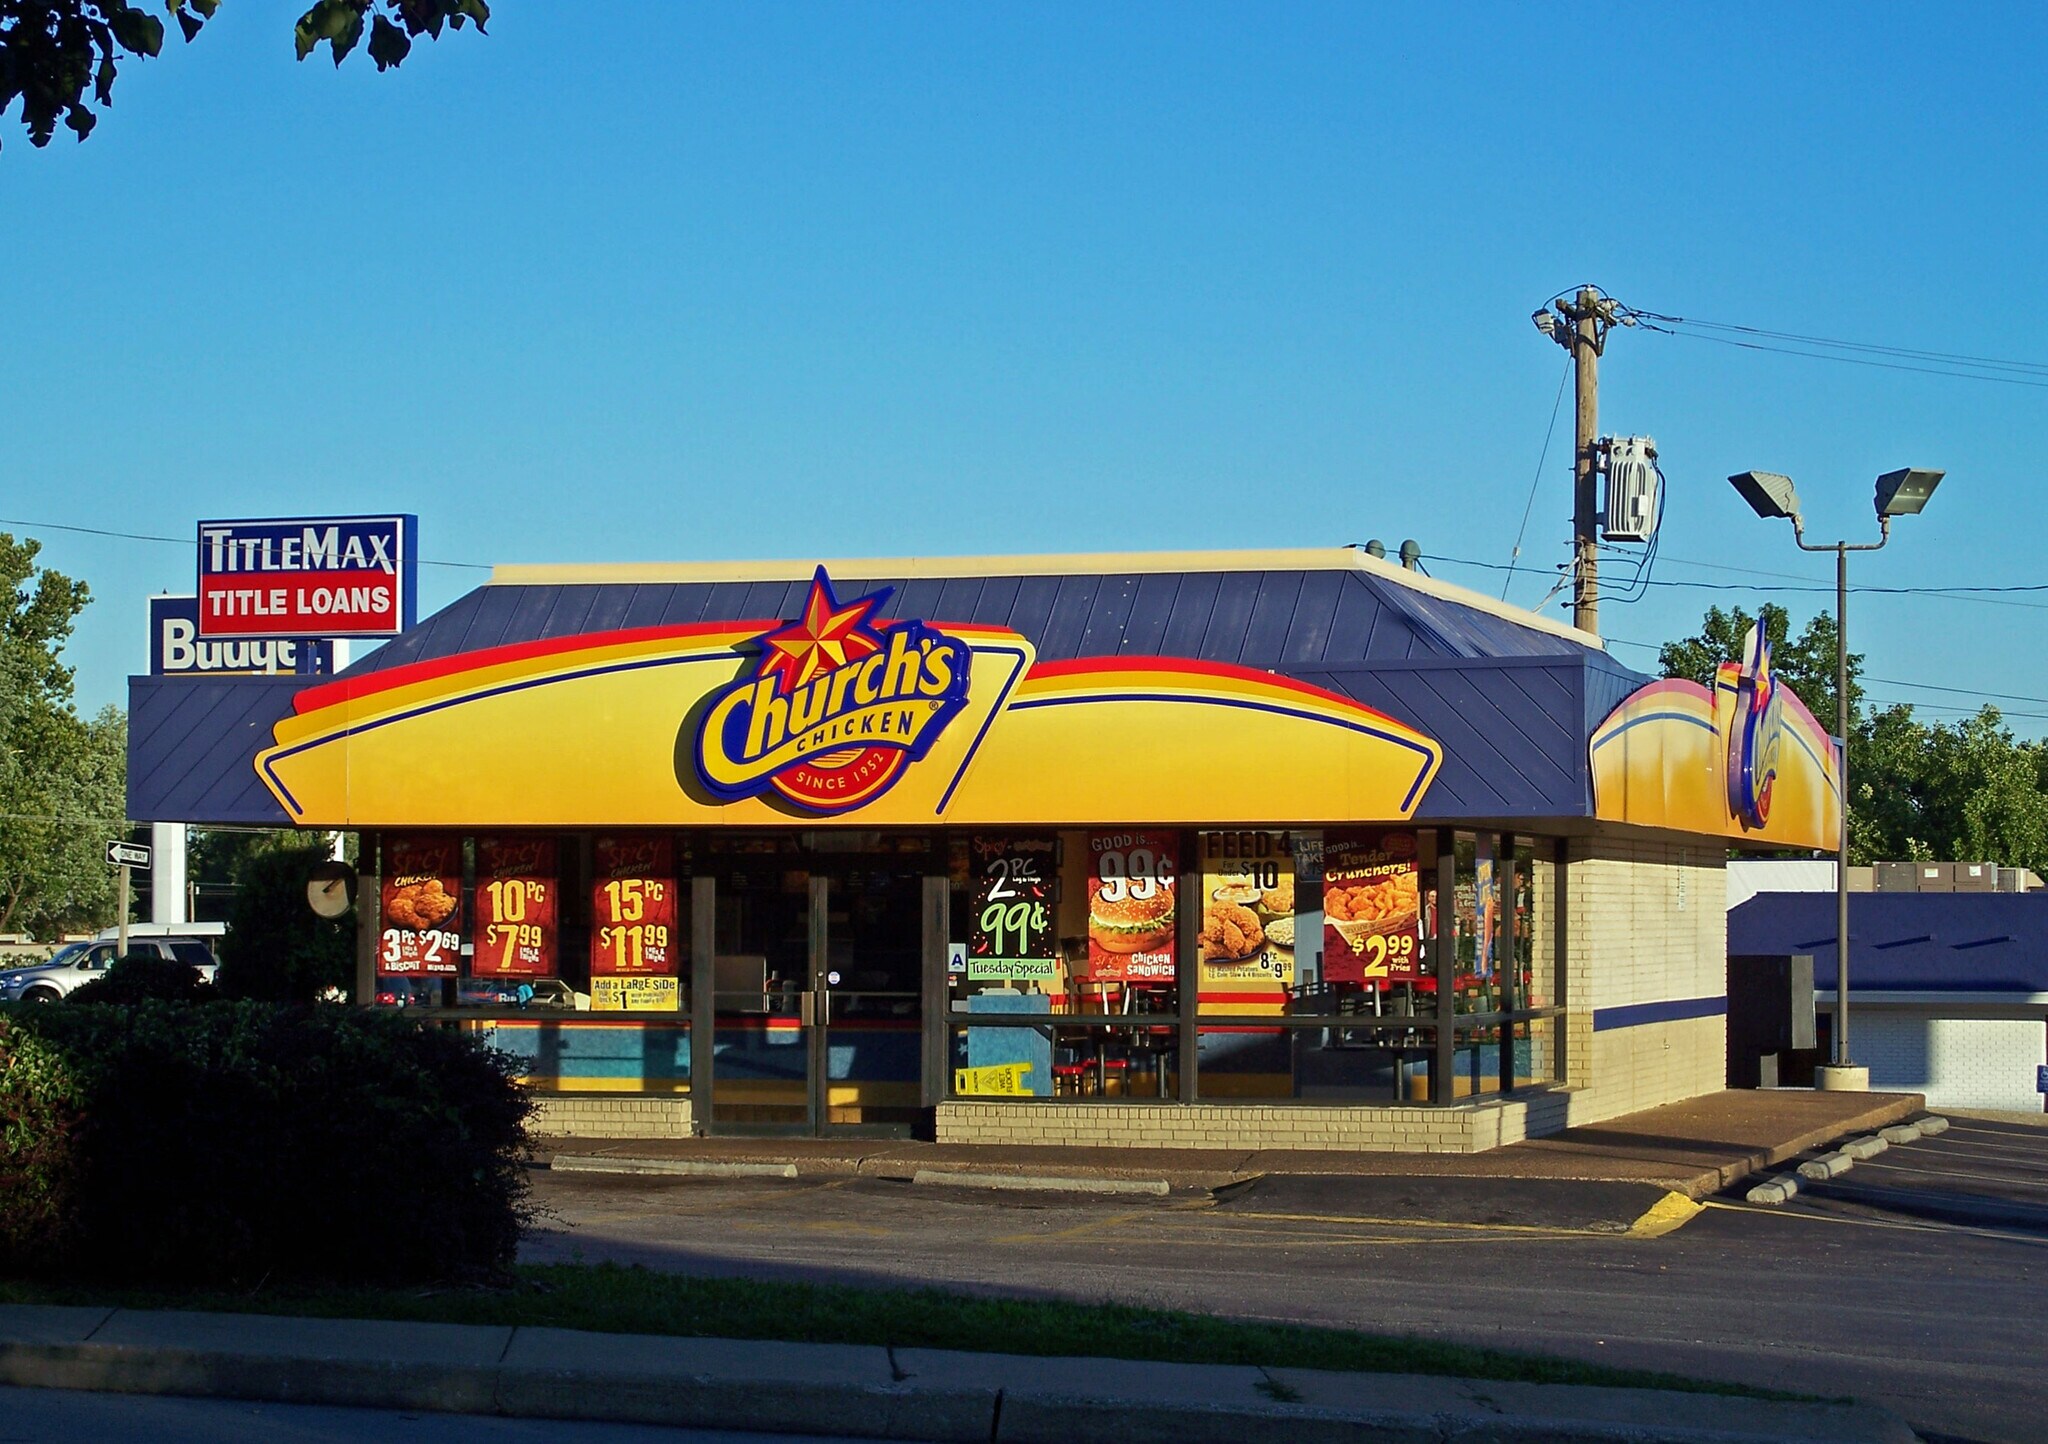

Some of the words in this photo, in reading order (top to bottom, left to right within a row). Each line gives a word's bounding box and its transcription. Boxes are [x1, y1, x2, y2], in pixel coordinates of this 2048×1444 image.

[207, 589, 288, 616] TITLE
[297, 586, 391, 614] LOANS
[702, 631, 955, 785] Church's
[796, 710, 914, 752] CHICKEN
[796, 771, 846, 790] SINCE
[853, 752, 885, 782] 1952
[121, 849, 133, 859] ONE
[134, 851, 147, 861] WAY
[491, 842, 545, 869] SPICY
[608, 840, 662, 867] SPICY
[974, 836, 1008, 860] Spicy
[1091, 834, 1132, 851] GOOD
[1206, 832, 1271, 858] FEED
[1277, 830, 1292, 858] 4
[610, 861, 652, 877] CHICKEN
[1339, 848, 1393, 866] Tender
[987, 858, 1016, 902] 2
[1010, 857, 1037, 876] PC
[1099, 848, 1176, 902] 99¢
[1217, 868, 1240, 877] Under
[1240, 860, 1279, 890] $10
[486, 879, 526, 922] 10
[526, 880, 546, 903] PC
[604, 878, 644, 922] 15
[644, 880, 664, 901] PC
[980, 901, 1049, 955] 99¢
[383, 928, 402, 962] 3
[401, 929, 416, 946] PC
[951, 953, 964, 966] A
[1261, 952, 1269, 969] 8
[1391, 955, 1409, 964] with
[594, 980, 611, 989] Add
[612, 991, 628, 1010] $1
[1005, 1067, 1013, 1093] FLOOR
